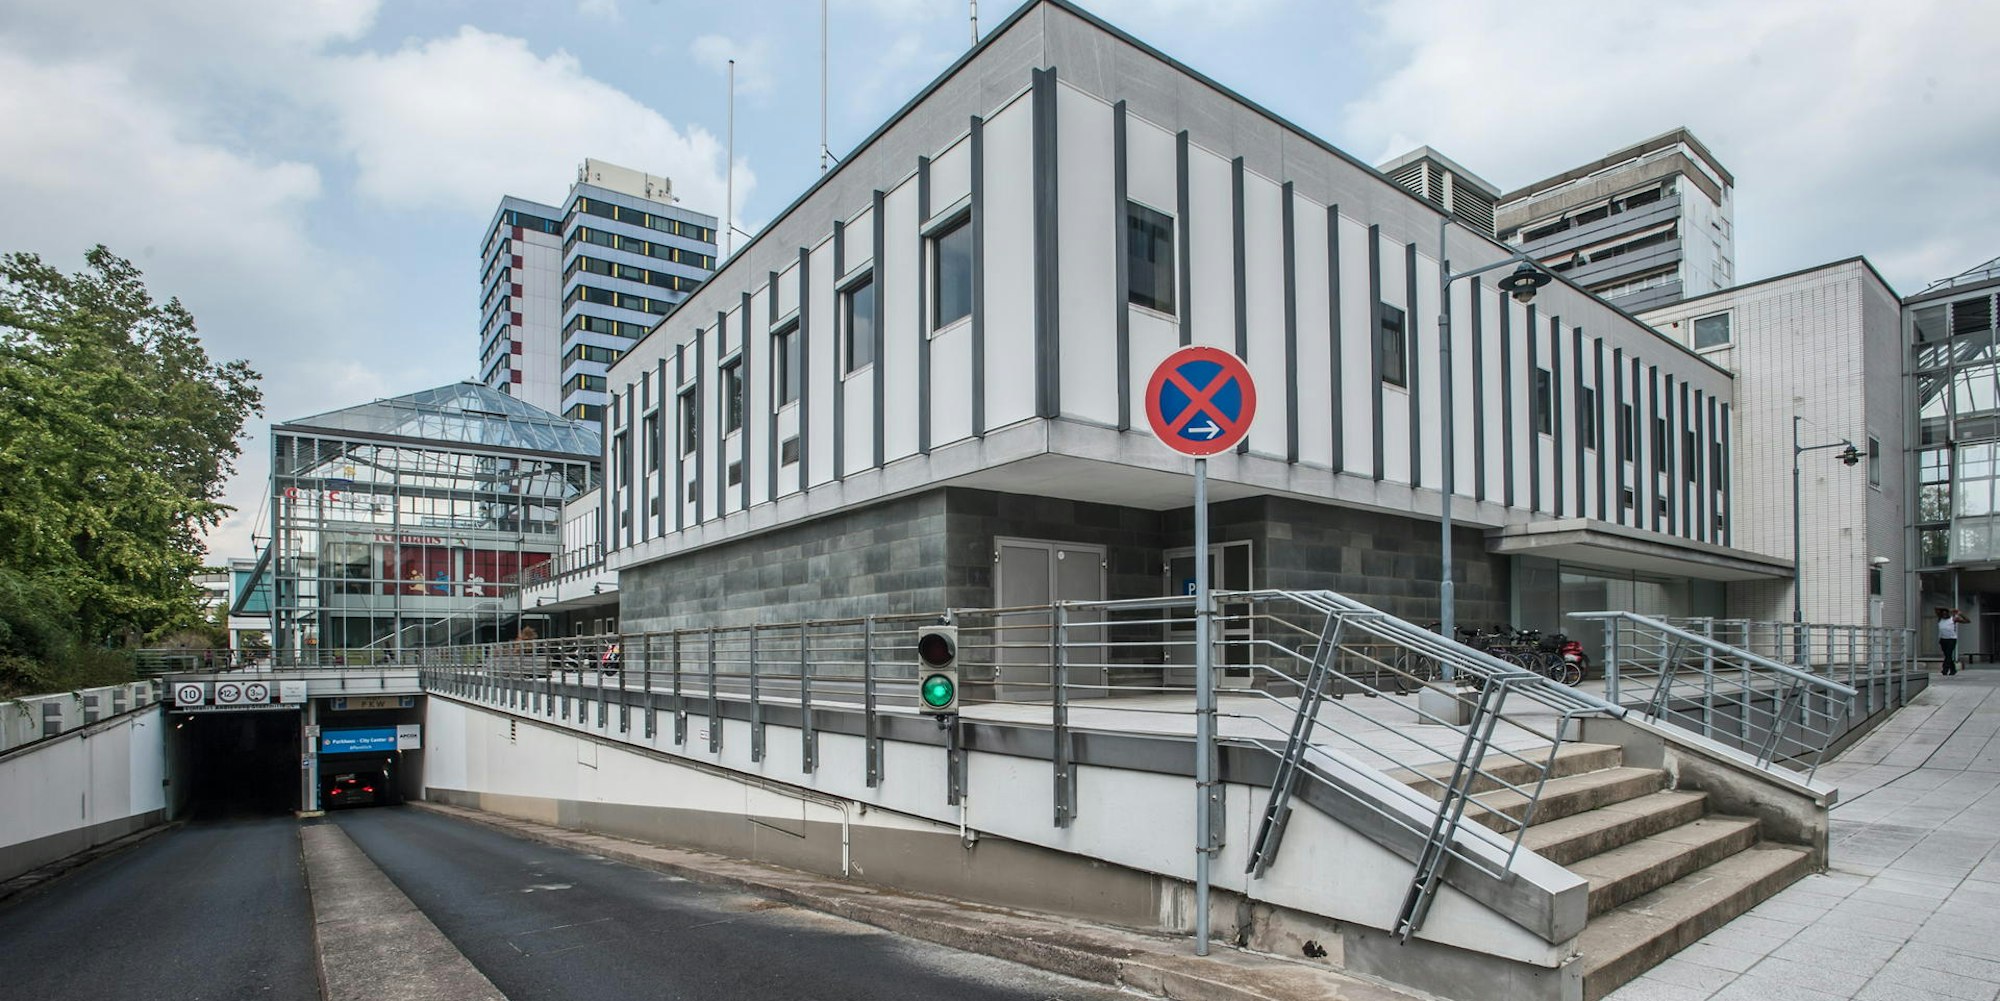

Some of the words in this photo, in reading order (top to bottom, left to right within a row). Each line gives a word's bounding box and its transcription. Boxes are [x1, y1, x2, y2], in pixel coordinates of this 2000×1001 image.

[1188, 582, 1196, 596] P
[184, 690, 196, 699] 10
[361, 700, 385, 708] PKW
